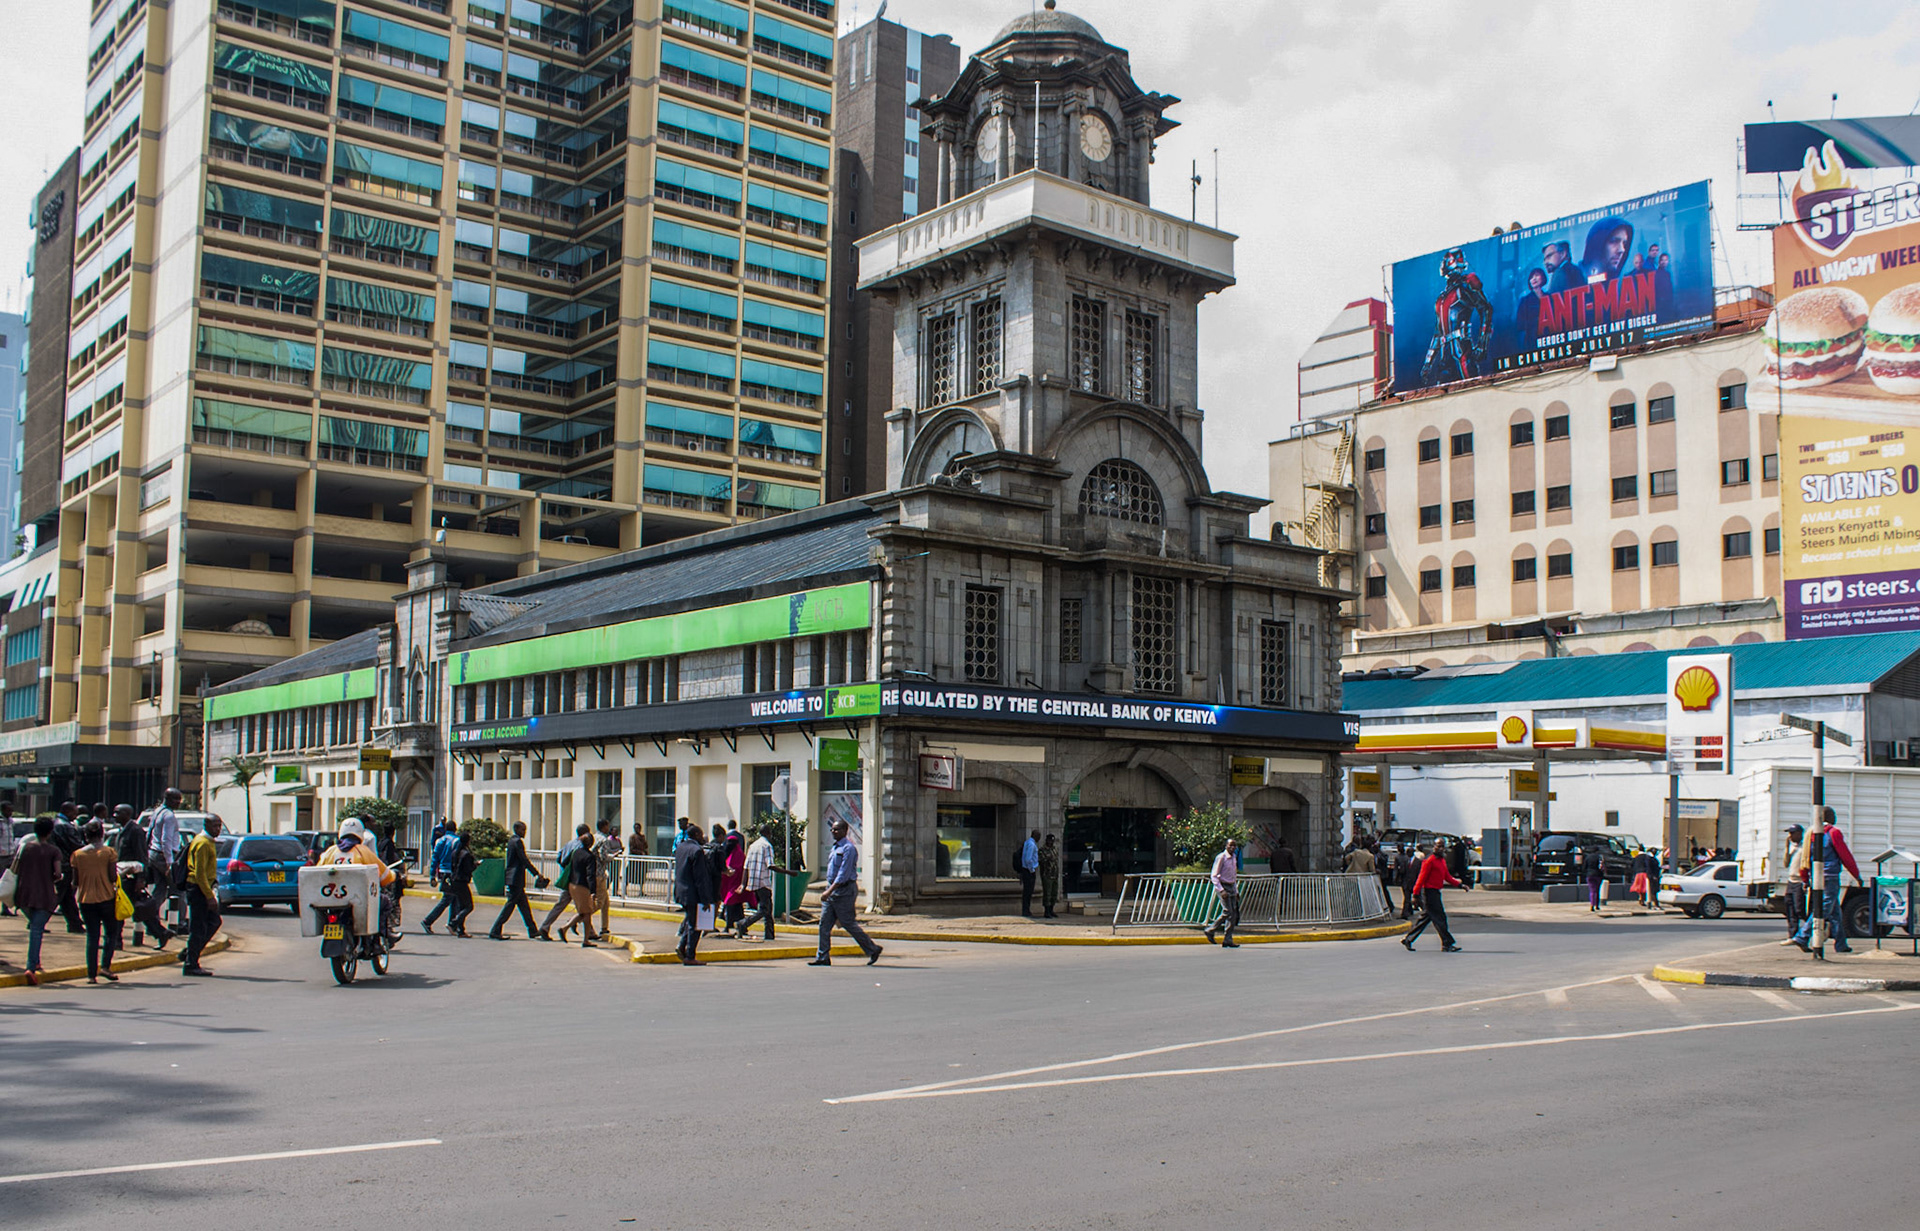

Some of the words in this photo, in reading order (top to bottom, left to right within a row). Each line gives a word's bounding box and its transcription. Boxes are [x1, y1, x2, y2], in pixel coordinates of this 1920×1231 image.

[1501, 233, 1518, 244] FROM
[1520, 230, 1532, 240] THE
[1534, 223, 1557, 236] STUDIO
[1559, 218, 1576, 229] THAT
[1578, 209, 1608, 224] BROUGHT
[1610, 205, 1624, 216] YOU
[1627, 201, 1640, 212] THE
[1642, 191, 1679, 207] AVENGERS
[1793, 267, 1819, 289] ALL
[1819, 253, 1877, 284] WACKY
[1537, 271, 1657, 336] ANT-MAN
[1536, 332, 1566, 349] HEROES
[1567, 327, 1591, 342] DON'T
[1592, 323, 1607, 337] GET
[1609, 320, 1625, 334] ANY
[1627, 313, 1657, 329] BIGGER
[1497, 357, 1510, 370] IN
[1517, 344, 1573, 366] CINEMAS
[1580, 336, 1612, 353] JULY
[1620, 331, 1634, 344] 17
[1799, 444, 1815, 453] TWO
[1870, 431, 1904, 443] BURGERS
[1800, 466, 1900, 504] STUDENTS
[1800, 507, 1862, 524] AVAILABLE
[1865, 505, 1881, 517] AT
[1801, 525, 1835, 537] Steers
[1838, 519, 1890, 533] Kenyatta
[1893, 515, 1903, 527] &
[1801, 538, 1835, 549] Steers
[1839, 532, 1880, 546] Muindi
[1801, 552, 1843, 563] Because
[1845, 547, 1881, 559] school
[1883, 546, 1892, 555] is
[814, 598, 844, 622] KCB
[751, 697, 805, 717] WELCOME
[807, 696, 823, 711] TO
[838, 694, 855, 708] KCB
[983, 695, 1003, 711] BY
[1008, 697, 1038, 713] THE
[1042, 699, 1108, 718] CENTRAL
[1111, 703, 1150, 721] BANK
[1153, 706, 1172, 722] OF
[1175, 708, 1217, 725] KENYA
[459, 730, 468, 742] TO
[468, 729, 482, 741] ANY
[482, 728, 495, 739] KCB
[496, 725, 528, 738] ACCOUNT
[321, 883, 348, 898] G4S
